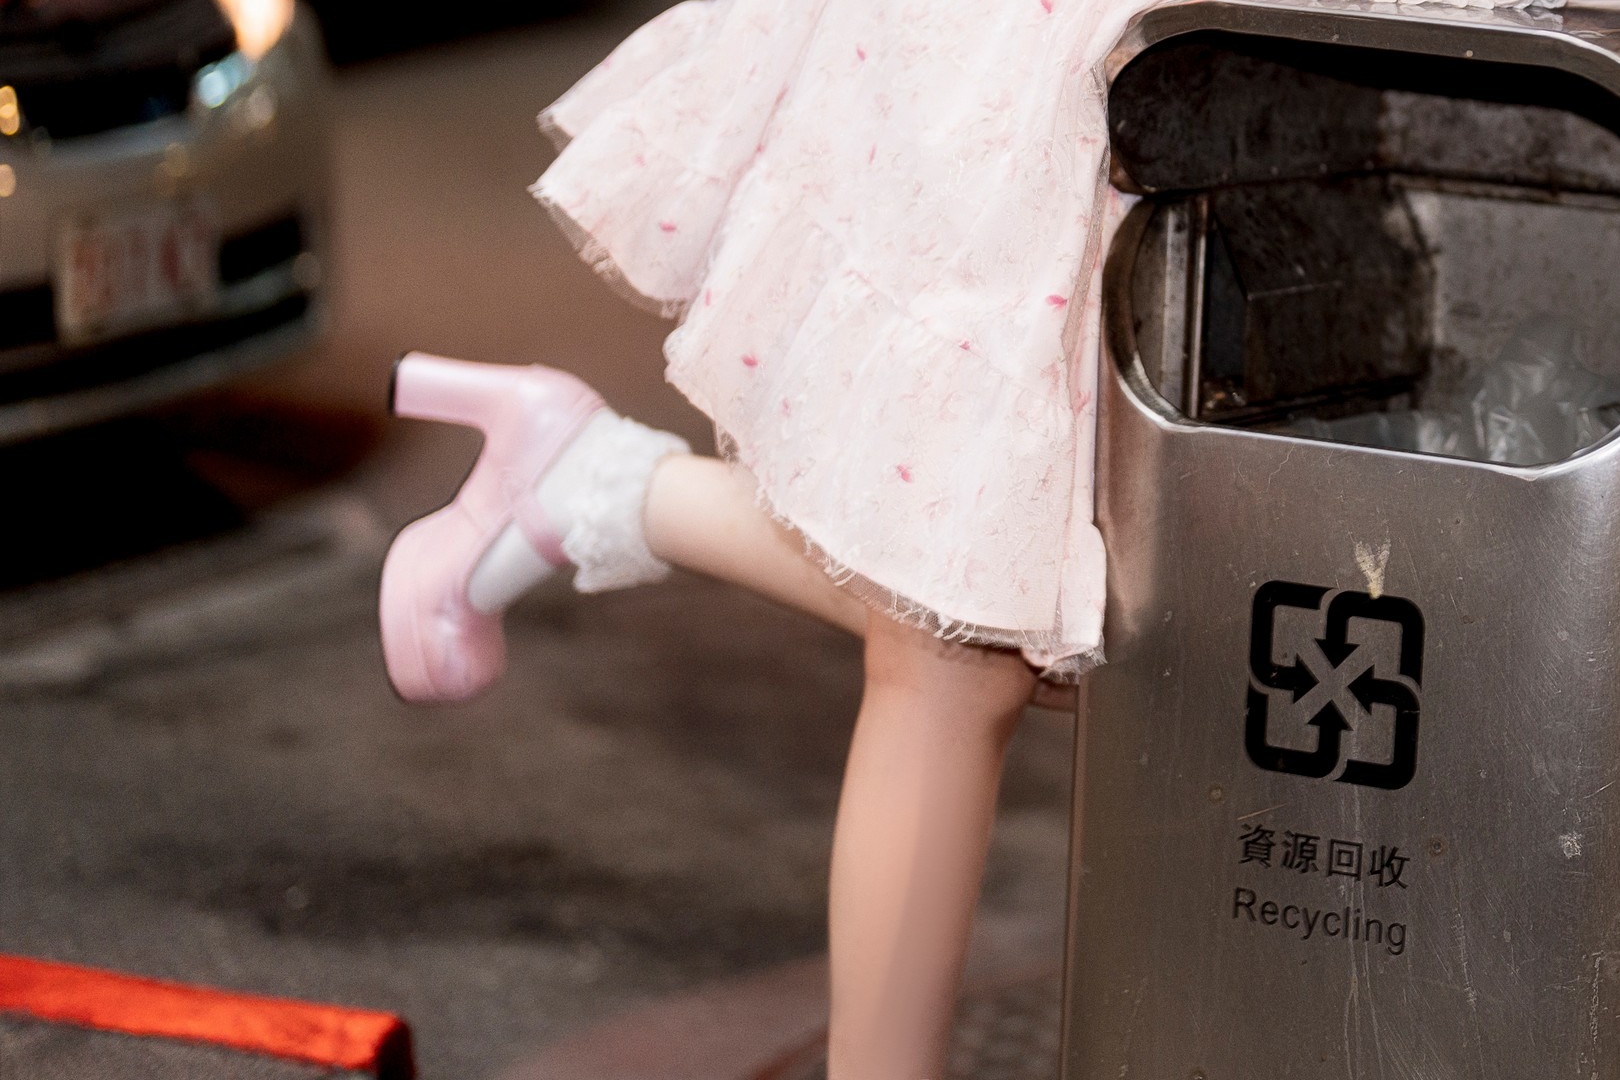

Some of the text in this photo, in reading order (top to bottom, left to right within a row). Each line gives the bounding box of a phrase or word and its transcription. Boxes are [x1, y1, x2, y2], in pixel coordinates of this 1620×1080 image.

[1238, 823, 1411, 890] 資源回收
[1232, 886, 1407, 956] Recycling
